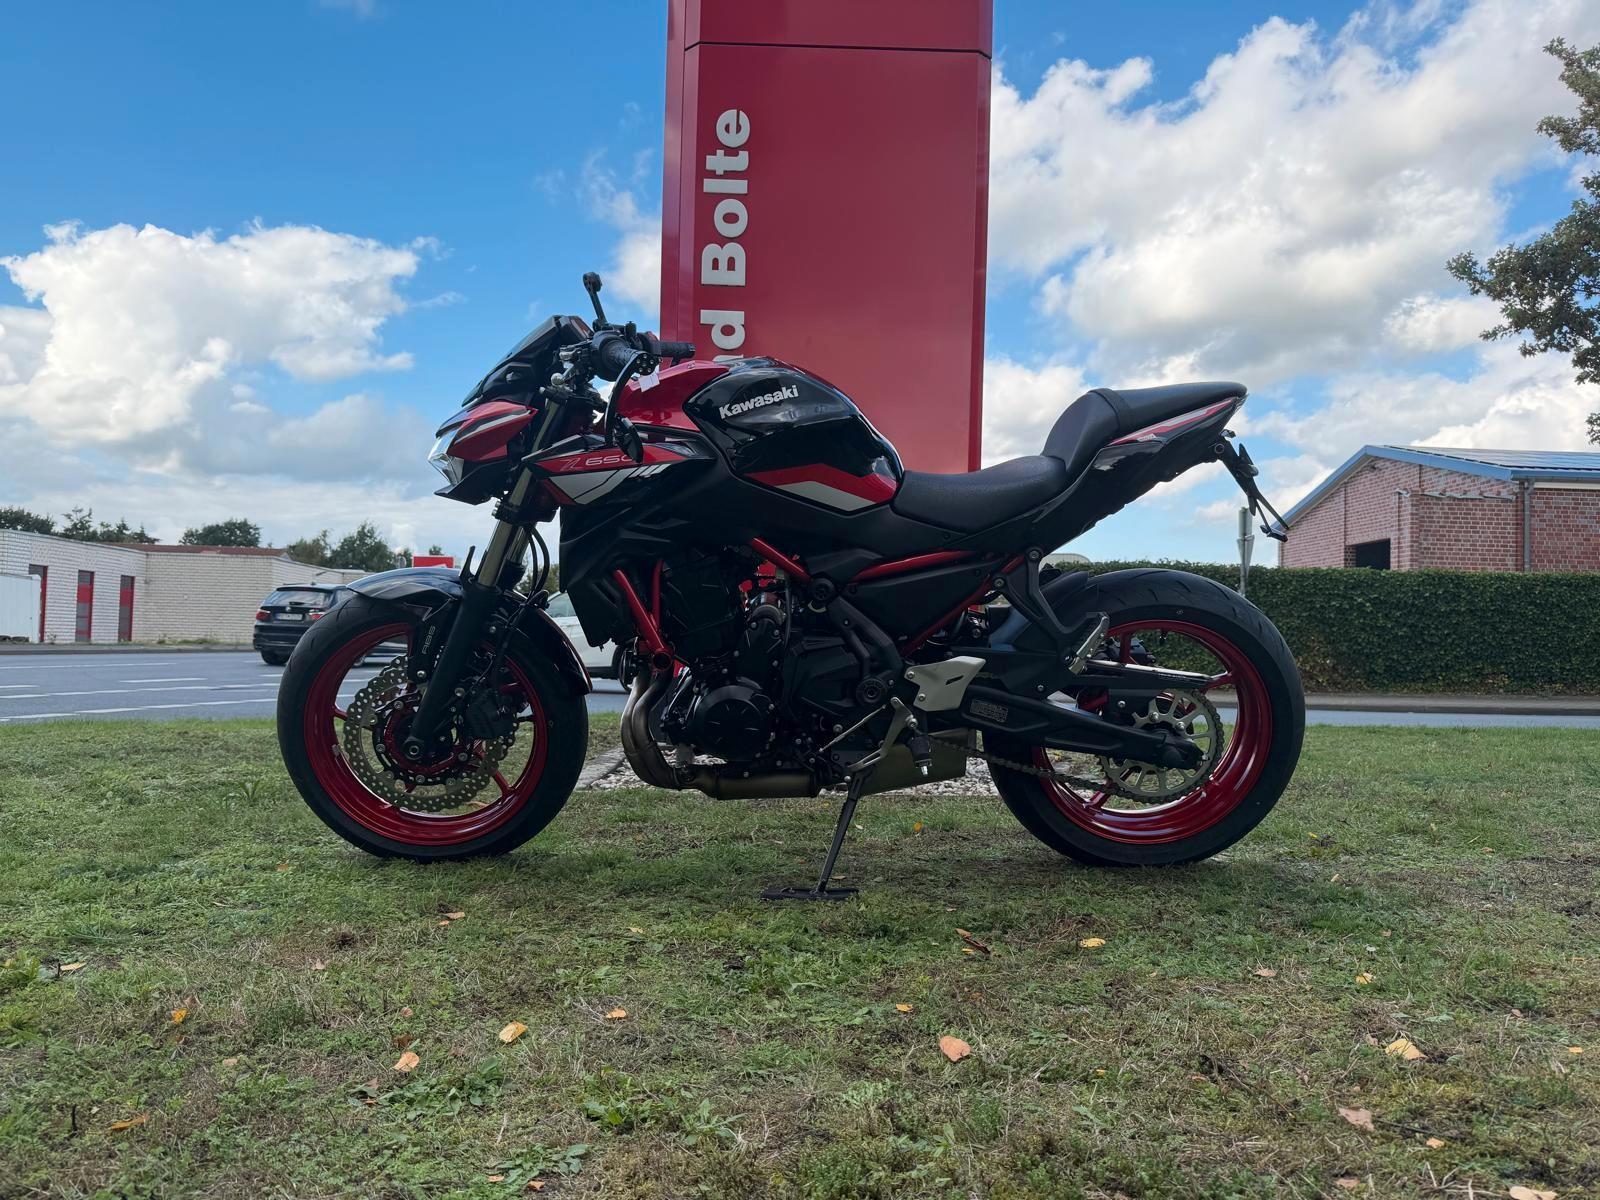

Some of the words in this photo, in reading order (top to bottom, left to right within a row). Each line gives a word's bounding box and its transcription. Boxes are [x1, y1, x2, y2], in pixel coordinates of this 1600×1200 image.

[701, 109, 750, 287] Bolte
[700, 309, 745, 361] d
[719, 385, 799, 419] Kawasaki
